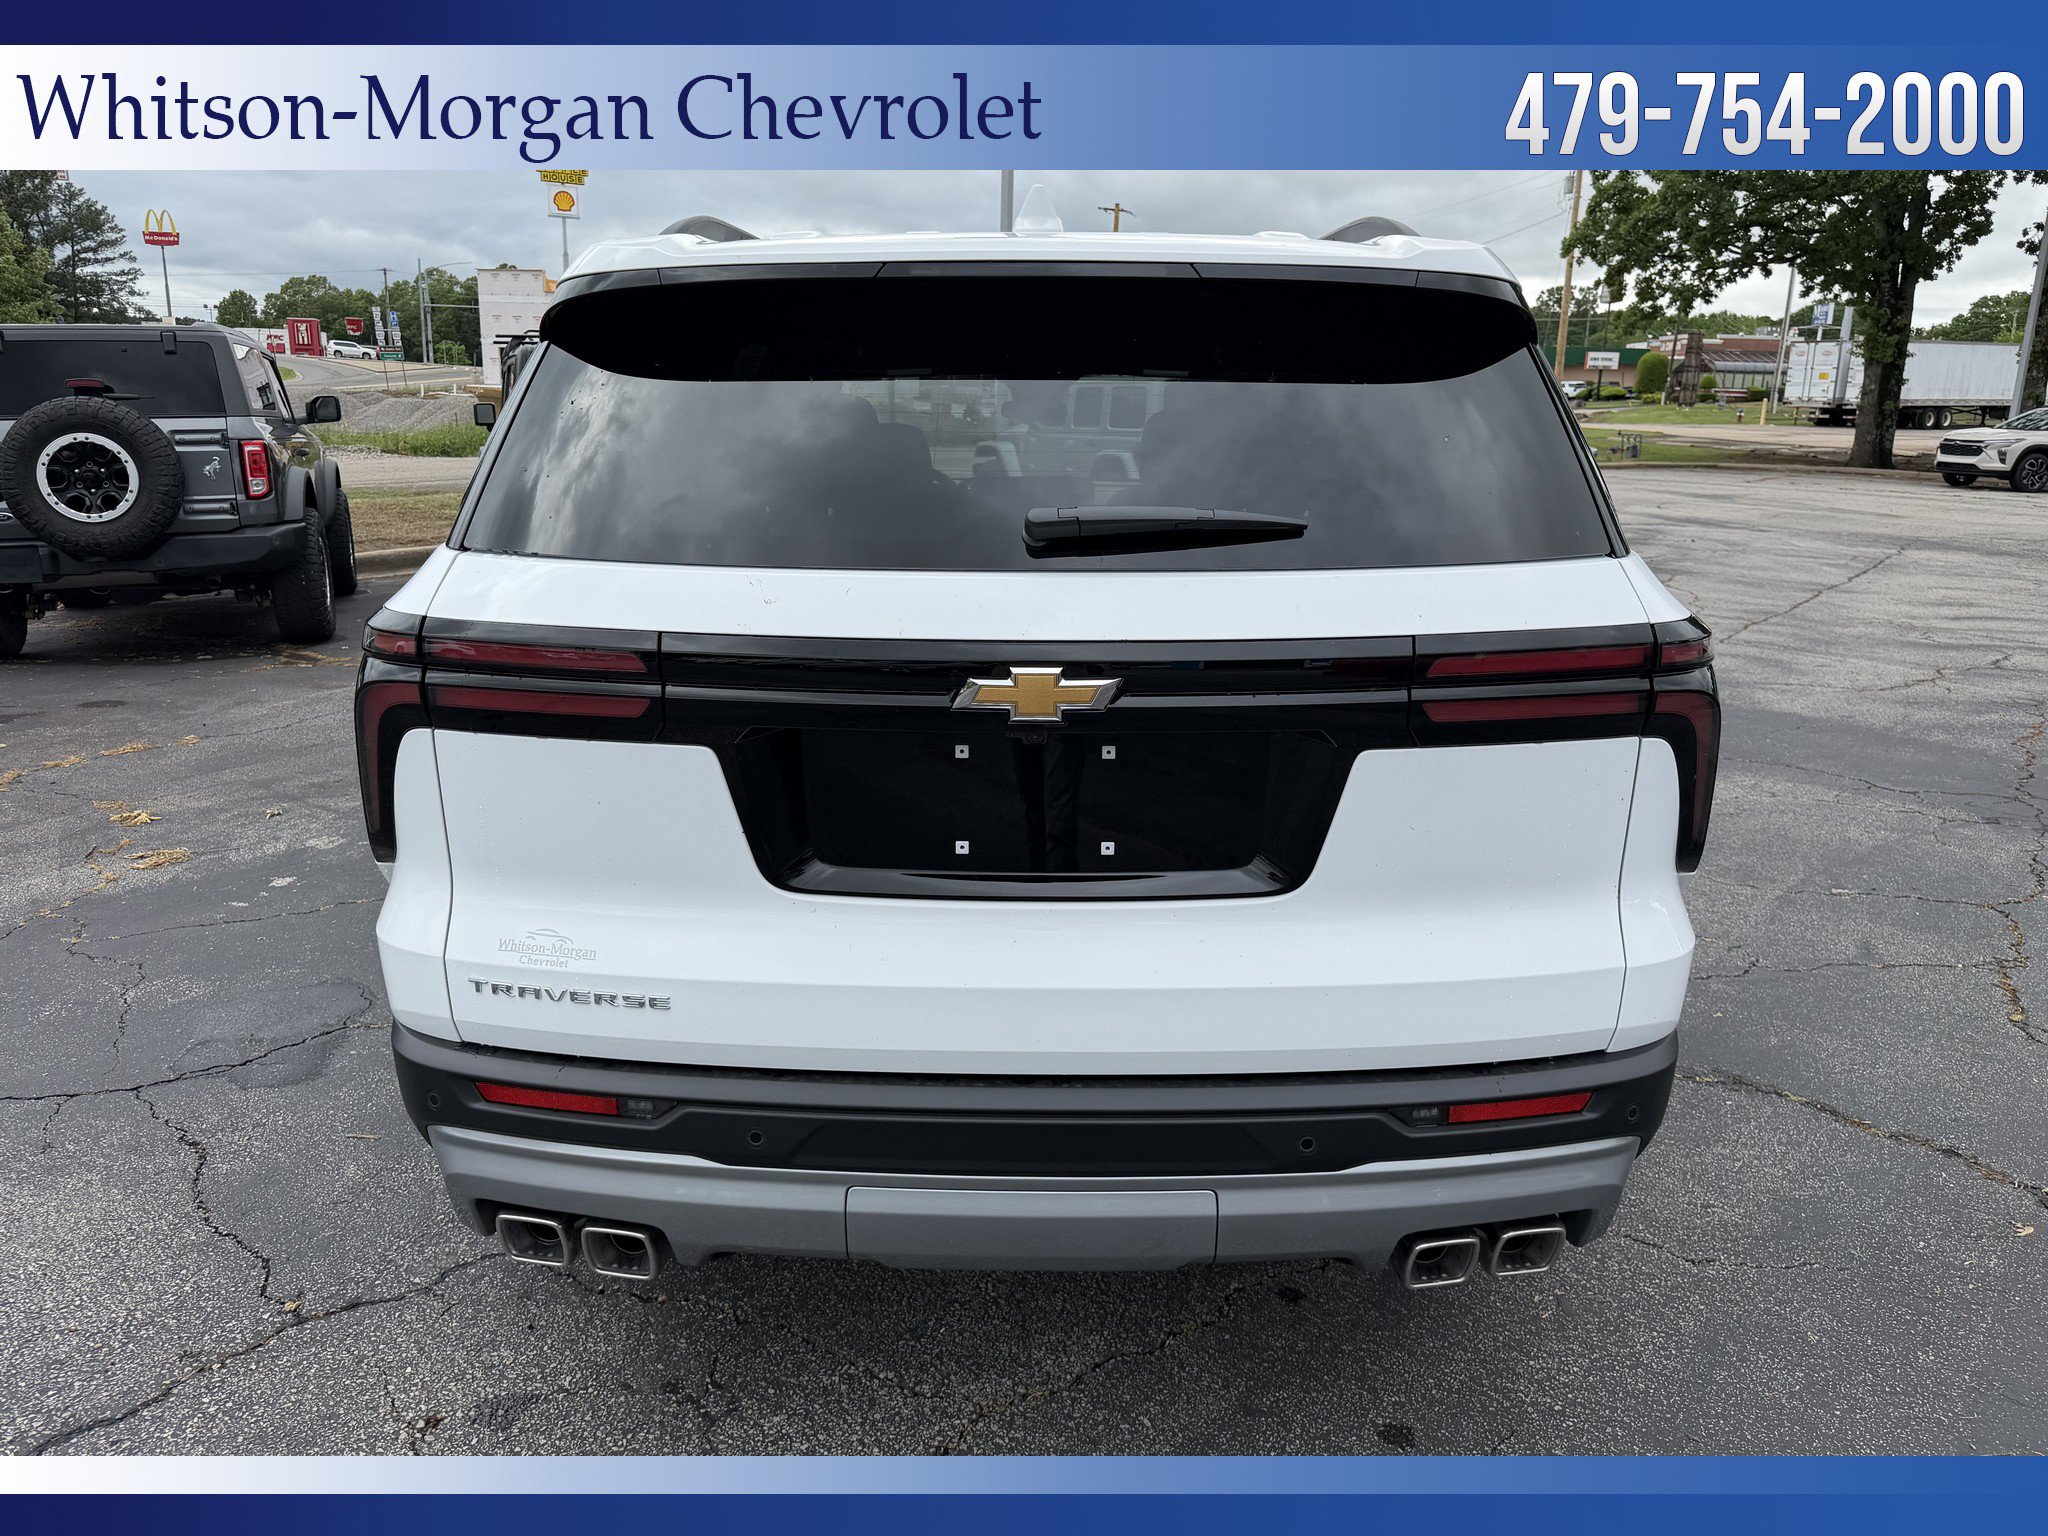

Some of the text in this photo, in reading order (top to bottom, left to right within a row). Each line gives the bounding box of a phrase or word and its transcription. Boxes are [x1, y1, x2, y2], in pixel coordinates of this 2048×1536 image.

[543, 172, 583, 183] HOUSE
[498, 938, 597, 960] Whitson-Morgan
[519, 955, 569, 968] Chevrolet
[467, 977, 671, 1010] TRAVERSE
